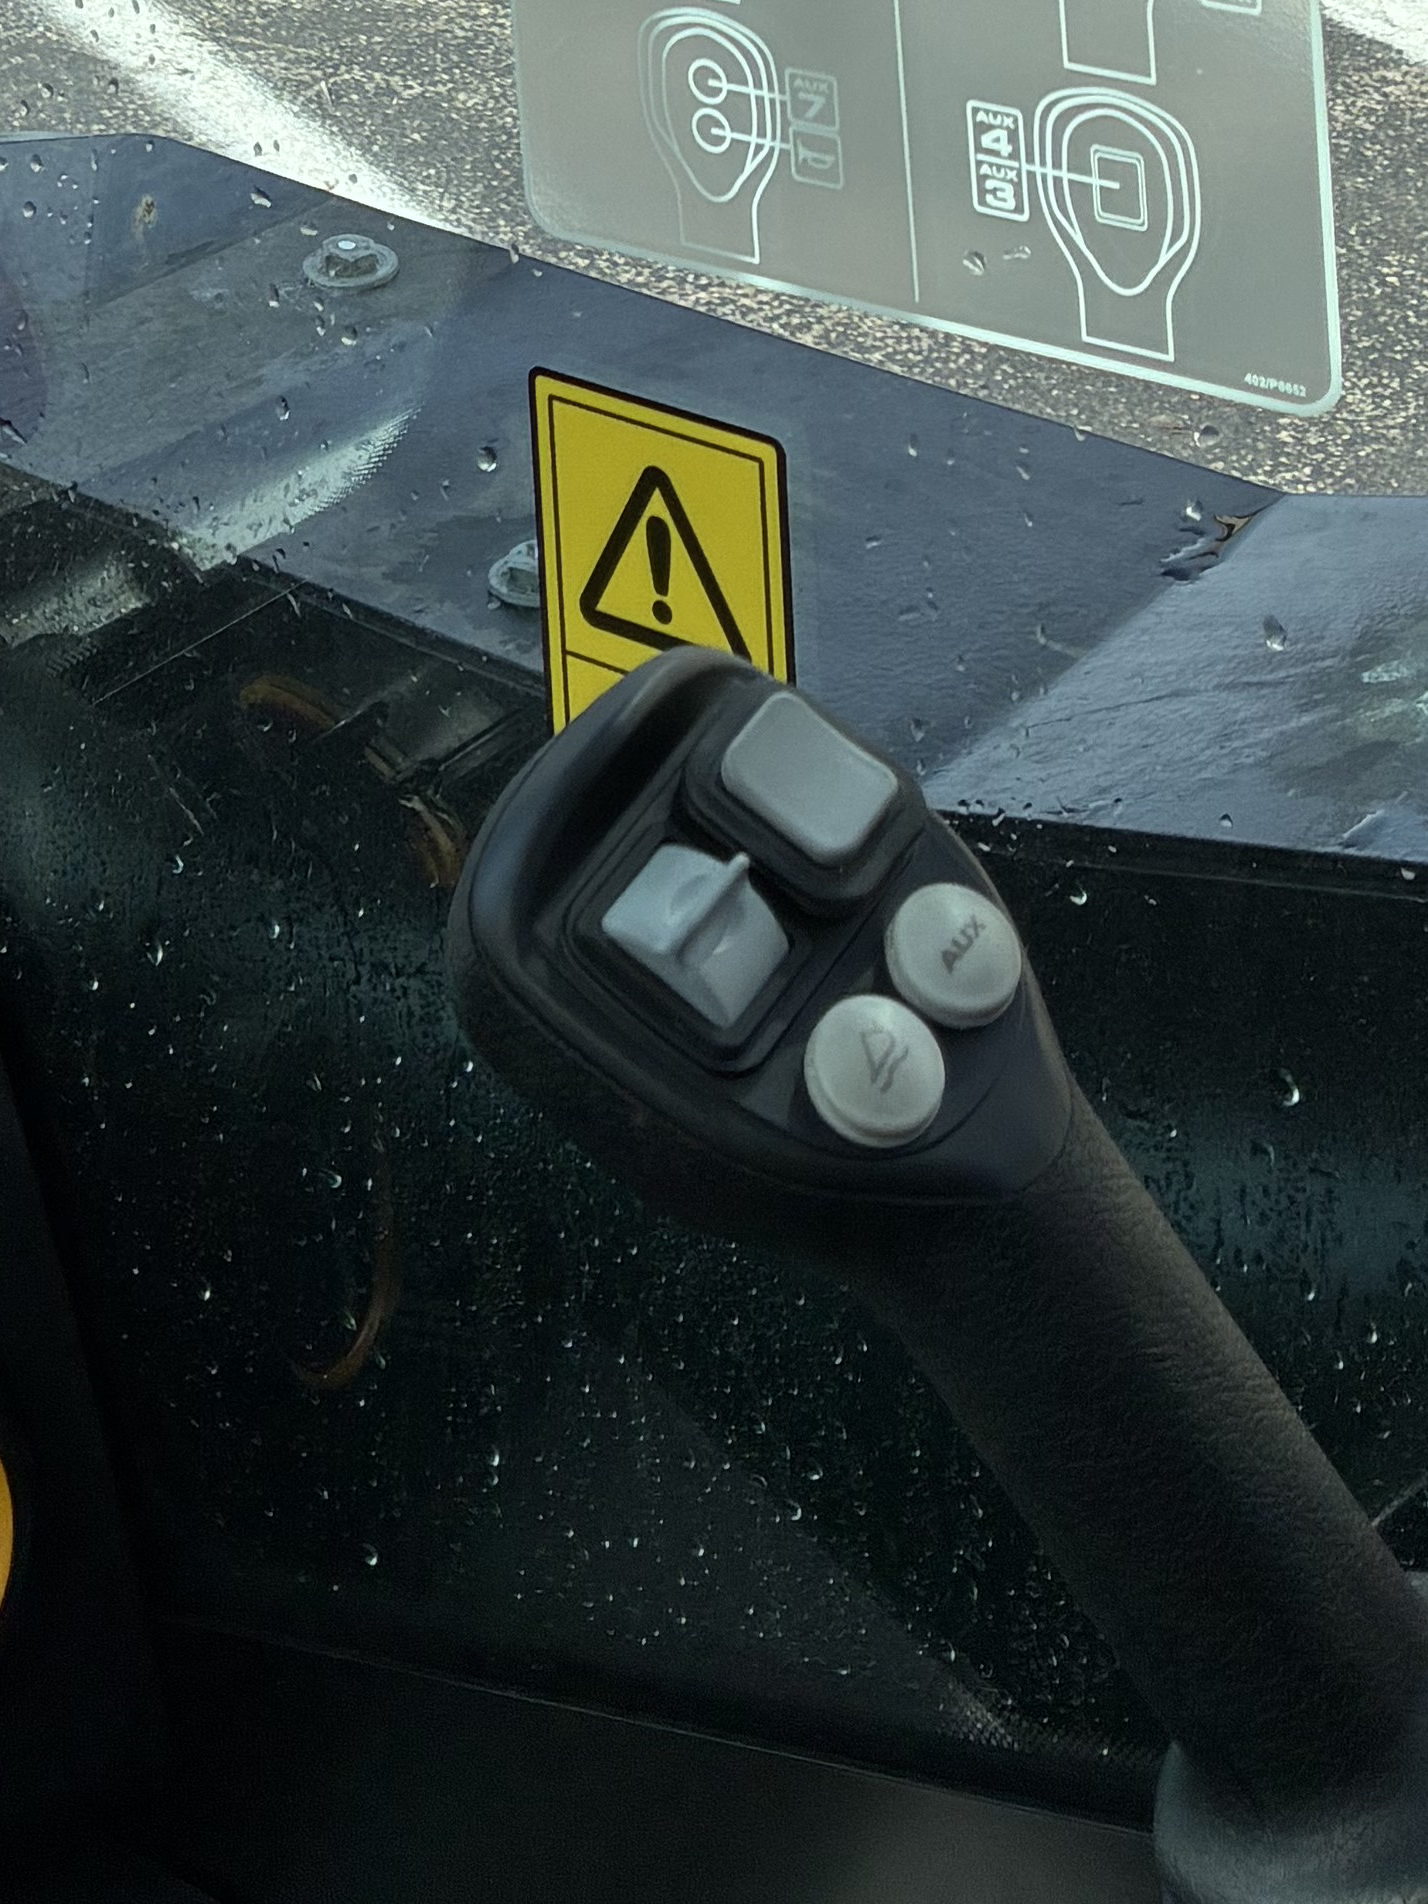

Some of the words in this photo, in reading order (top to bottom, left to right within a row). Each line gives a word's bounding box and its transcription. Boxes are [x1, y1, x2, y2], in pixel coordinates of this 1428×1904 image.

[793, 77, 829, 94] AUX
[797, 90, 827, 119] 7
[975, 110, 1016, 130] AUX
[980, 128, 1013, 158] 4
[978, 163, 1019, 183] AUX
[984, 178, 1016, 212] 3
[940, 913, 987, 976] AUX
